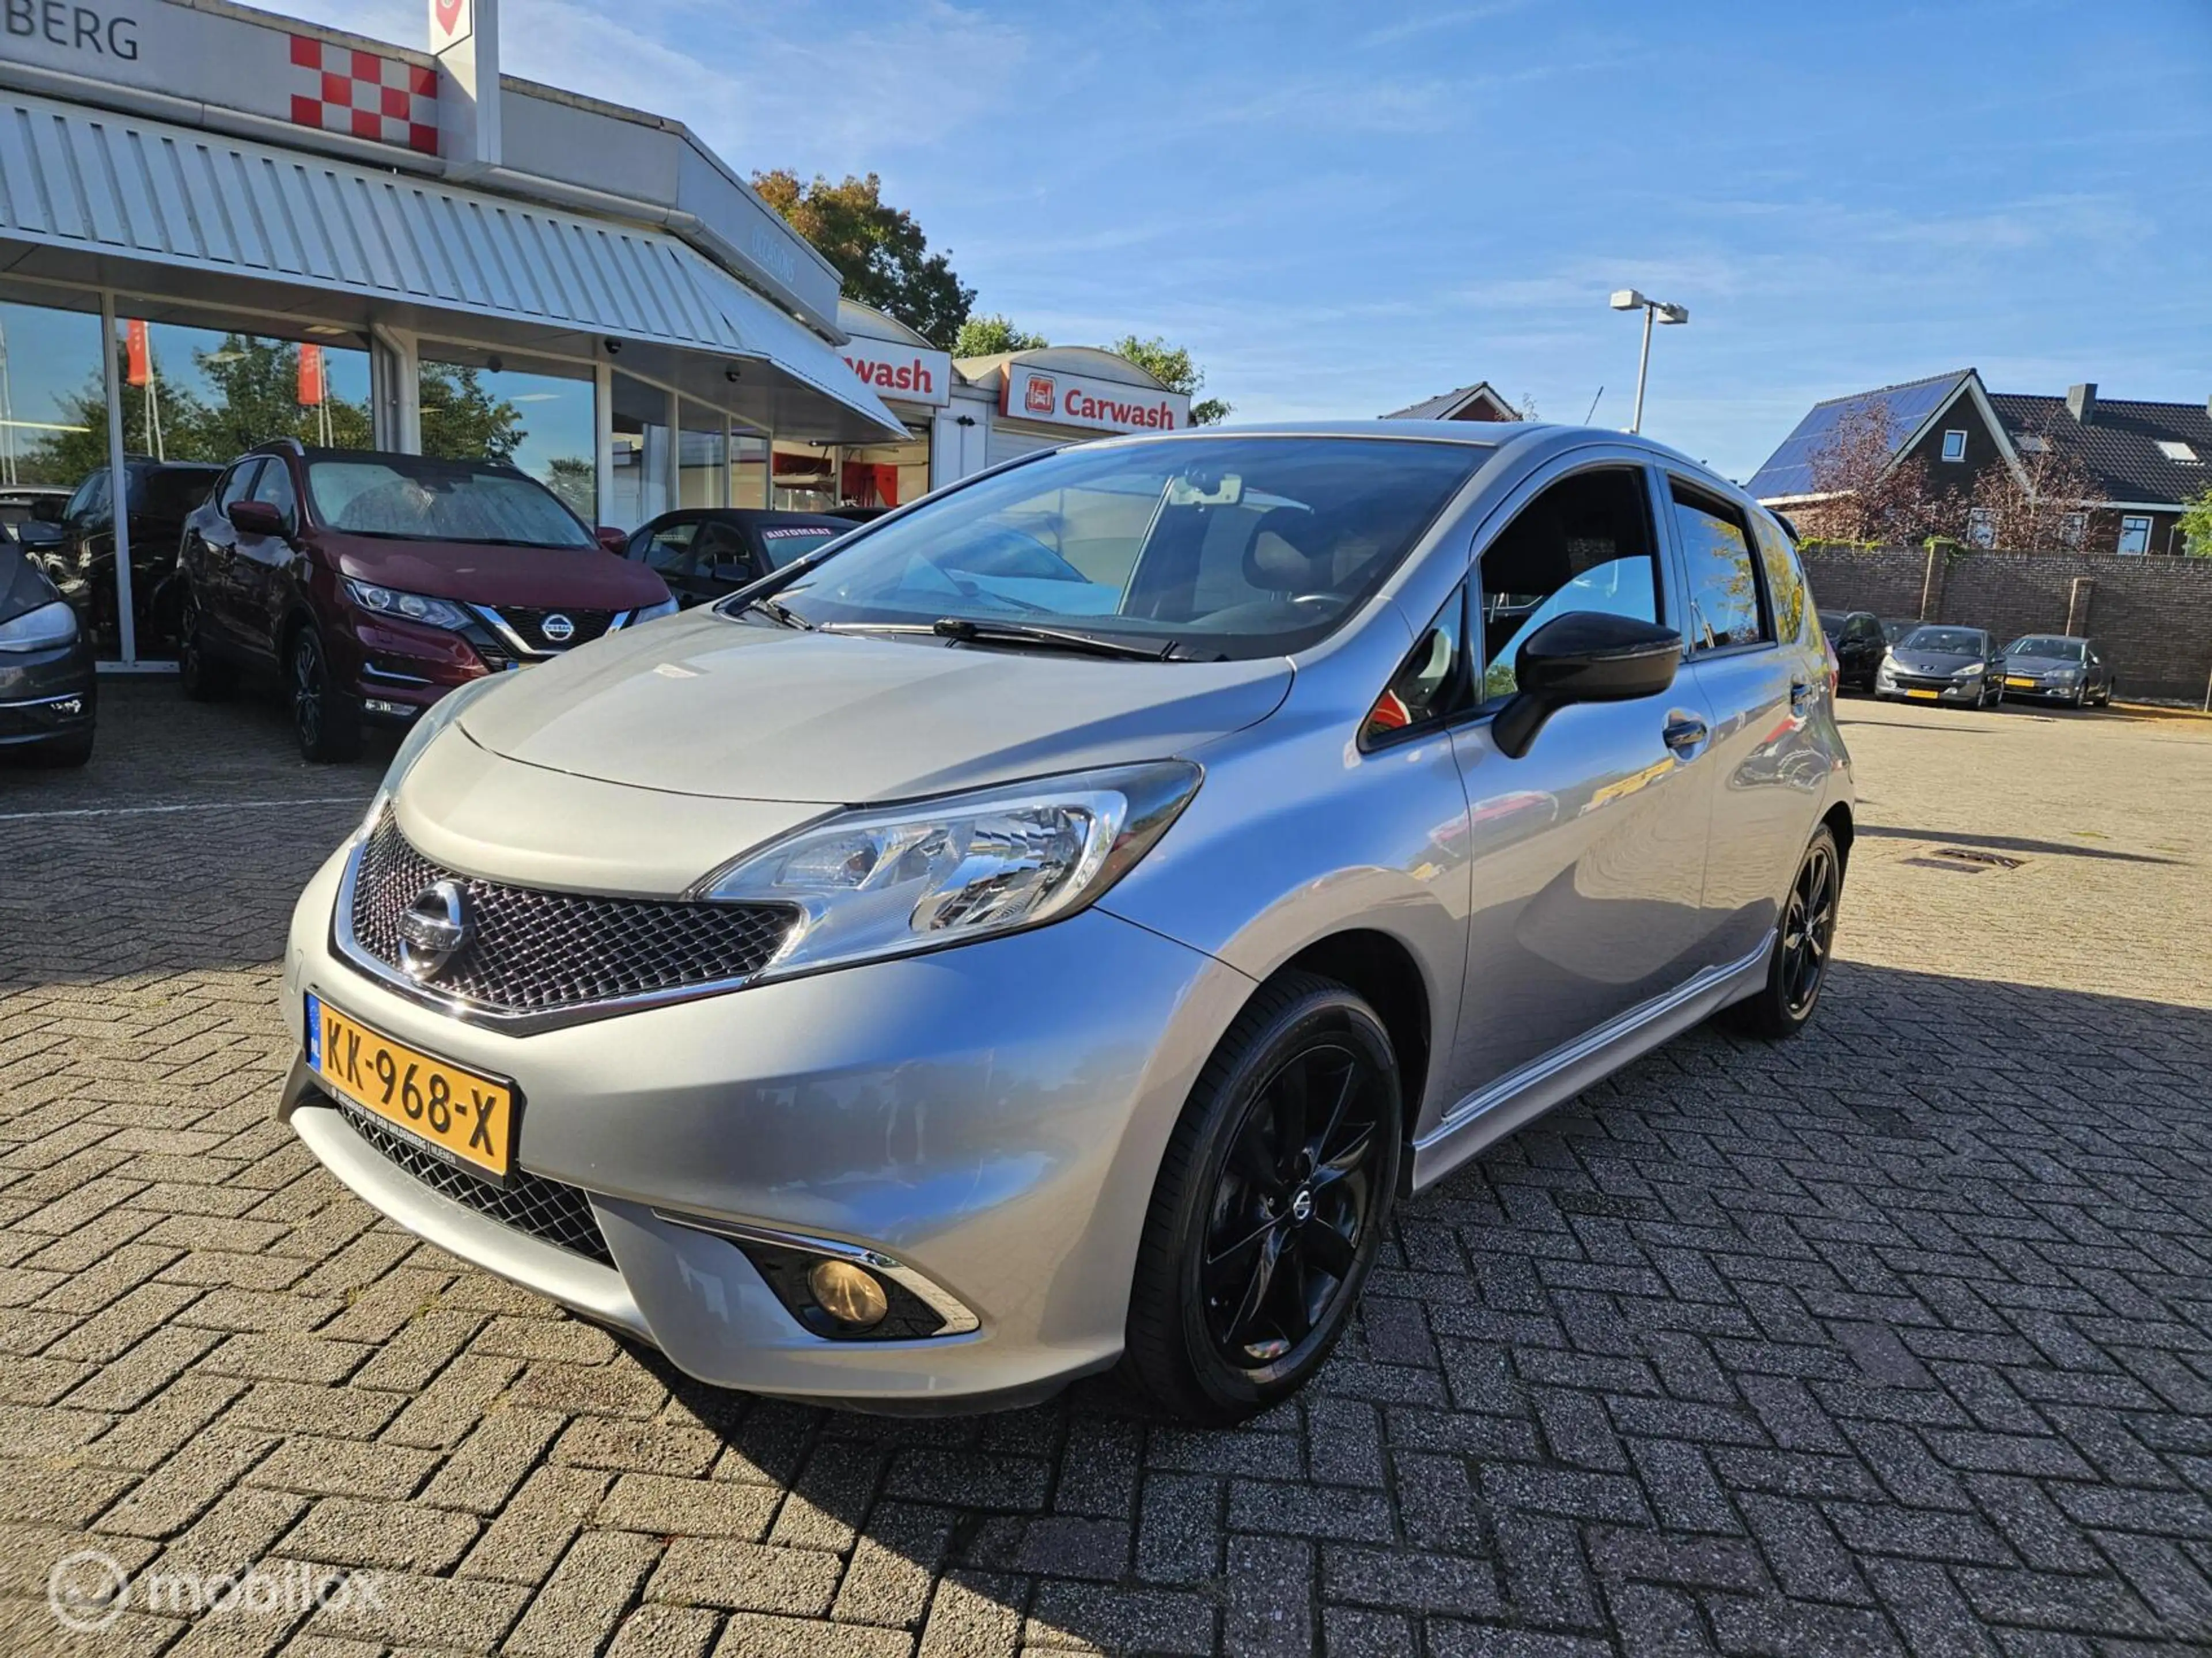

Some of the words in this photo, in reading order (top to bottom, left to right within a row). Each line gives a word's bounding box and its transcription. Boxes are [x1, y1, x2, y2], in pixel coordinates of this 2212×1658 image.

[1065, 389, 1175, 430] Carwash
[766, 528, 831, 539] AUTOMAAT
[327, 1017, 497, 1157] KK-968-X
